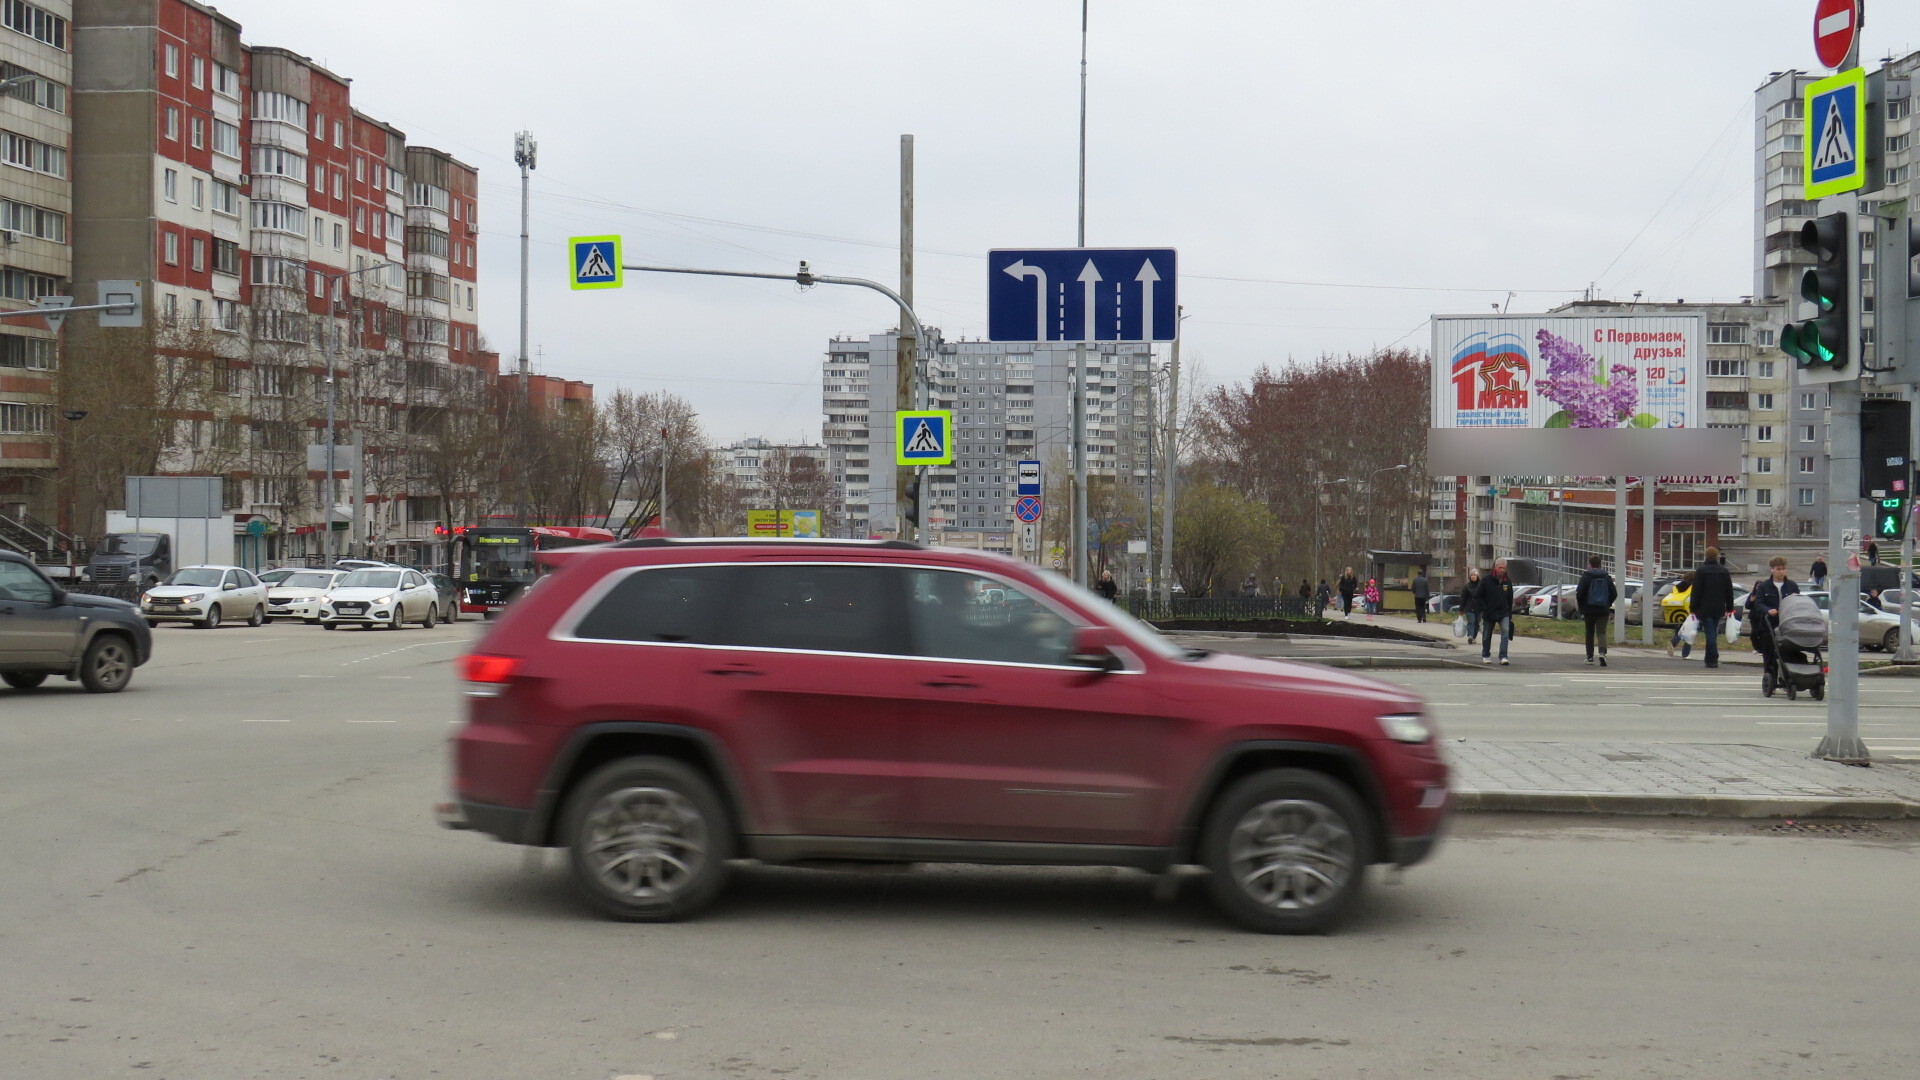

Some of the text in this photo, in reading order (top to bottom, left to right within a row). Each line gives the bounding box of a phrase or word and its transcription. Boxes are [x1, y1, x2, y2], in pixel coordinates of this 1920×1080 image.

[1594, 329, 1686, 345] С Первомаем,
[1634, 344, 1686, 361] друзья!
[1646, 367, 1665, 379] 120
[1452, 367, 1528, 410] 1 МАЯ
